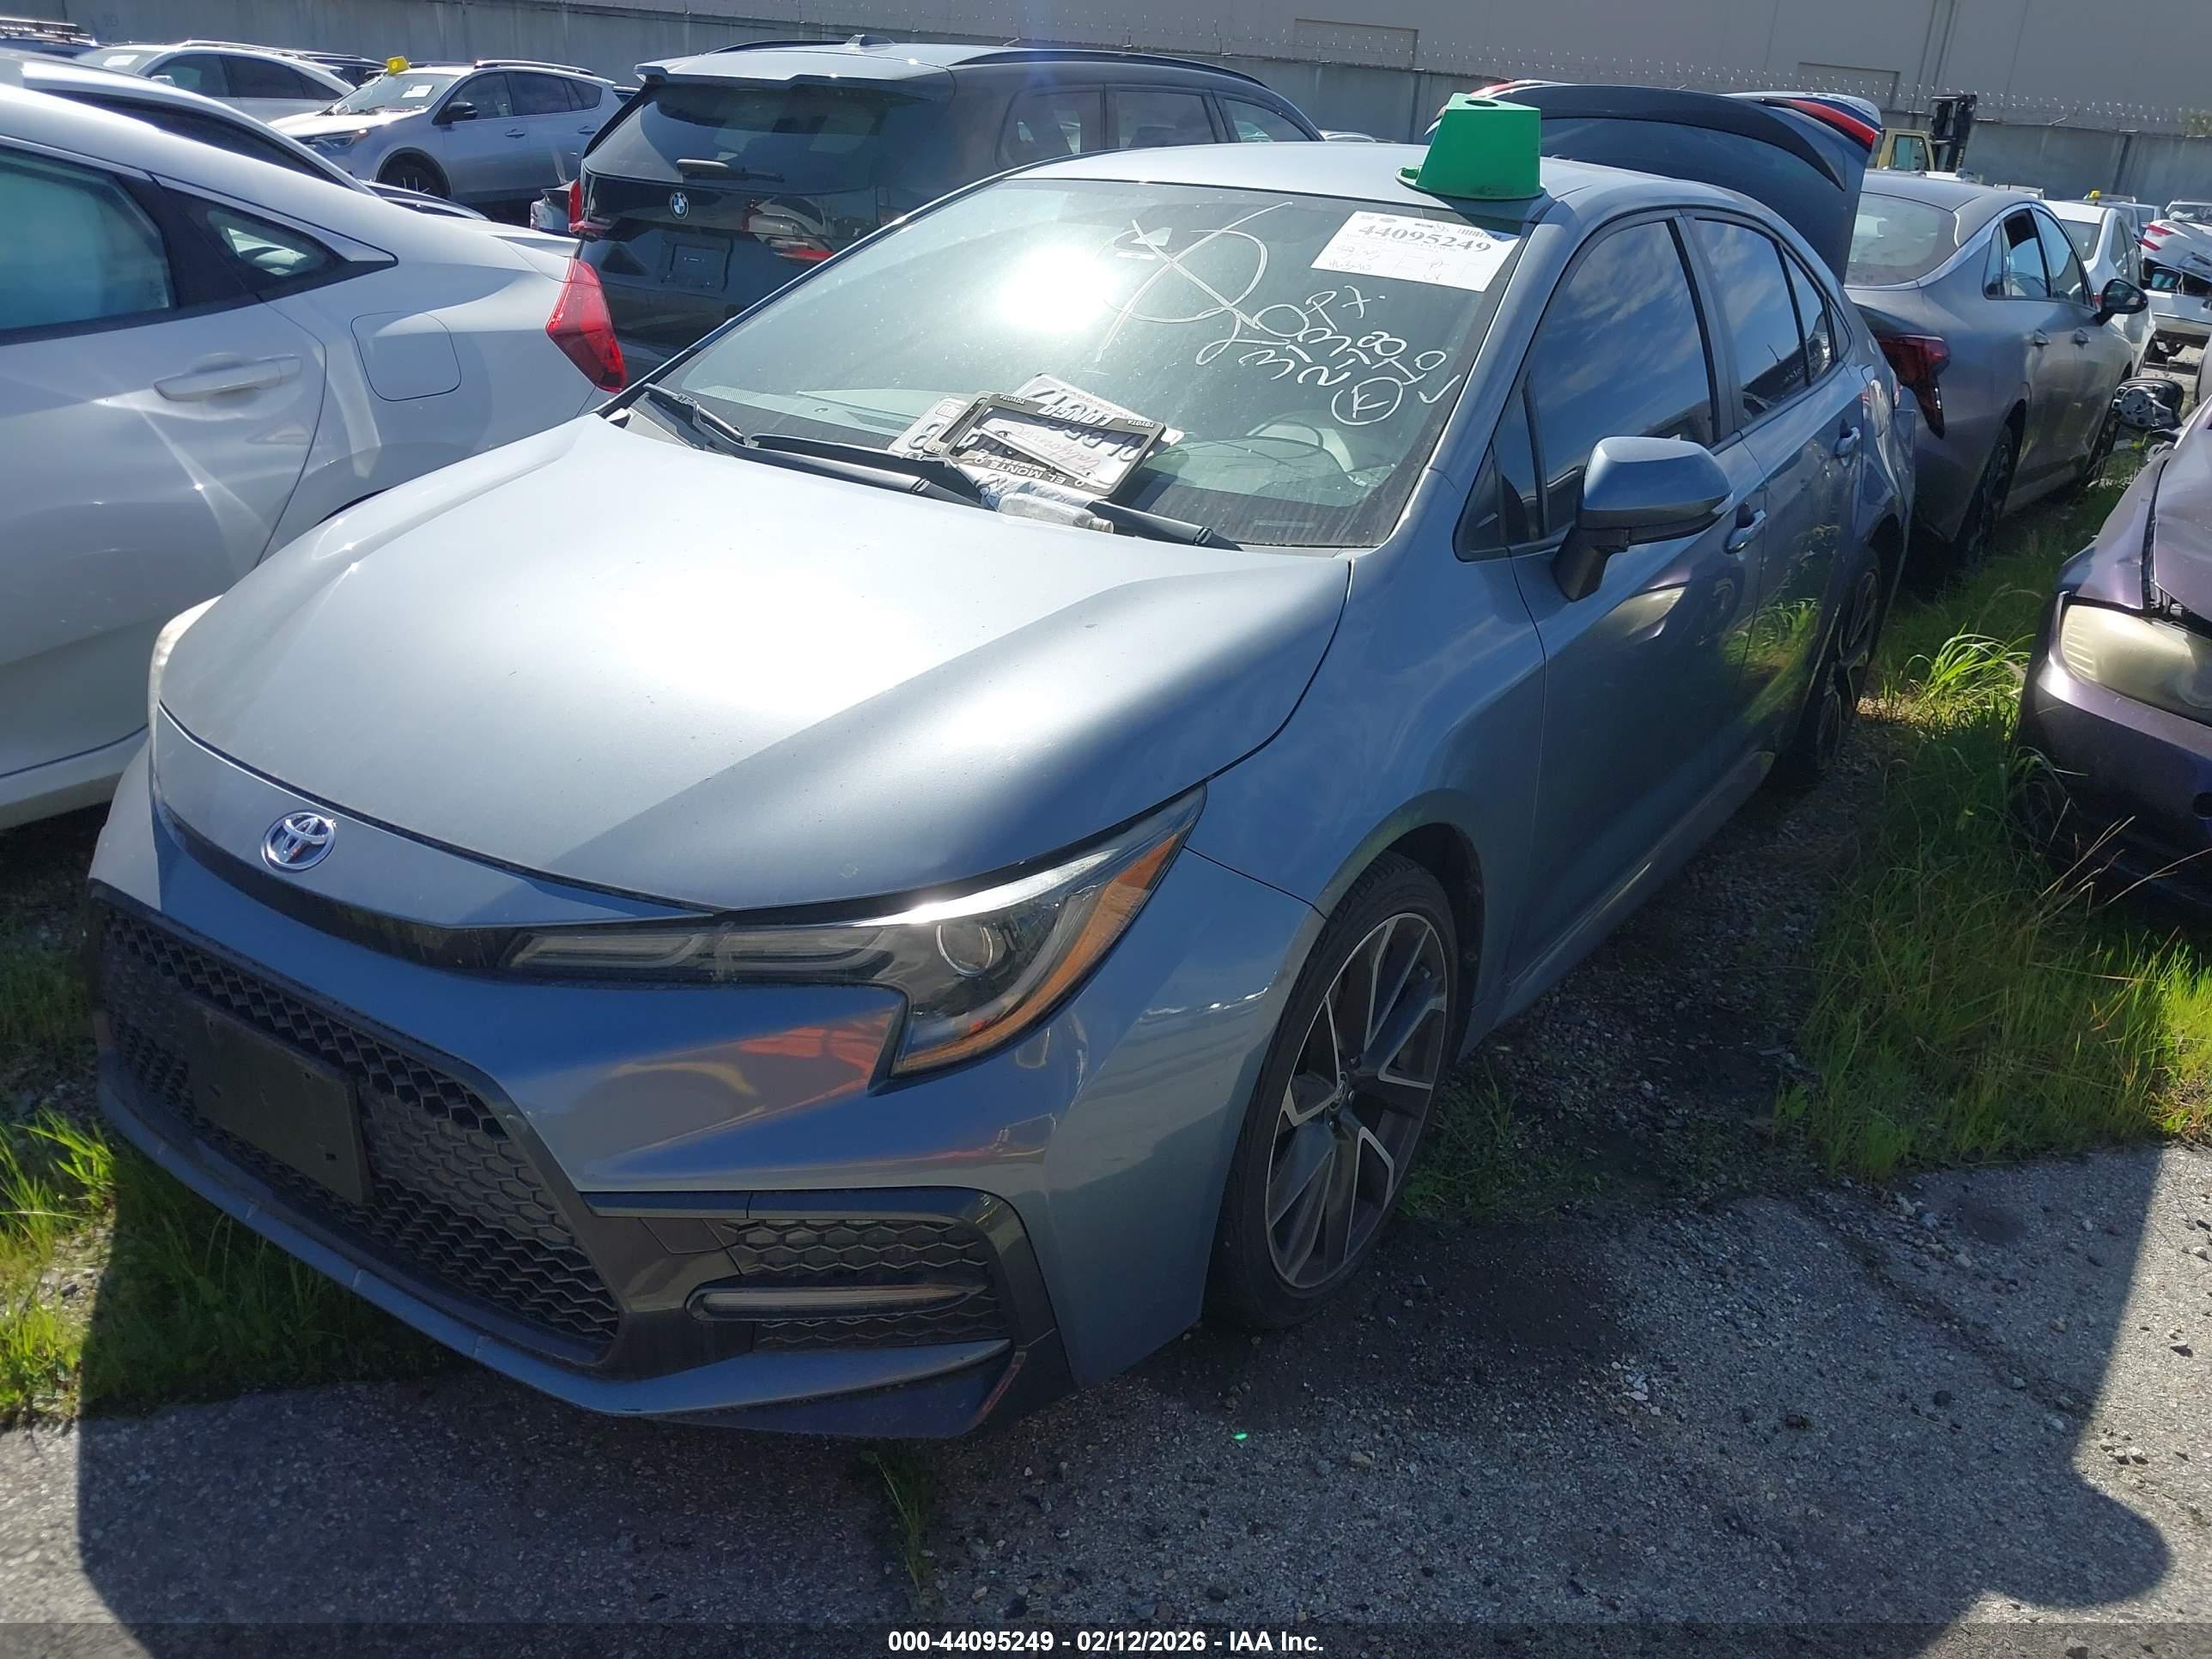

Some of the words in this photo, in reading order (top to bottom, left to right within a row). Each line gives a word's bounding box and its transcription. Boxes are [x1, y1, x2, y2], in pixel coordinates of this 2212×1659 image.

[1358, 223, 1492, 252] 44095249
[999, 393, 1026, 405] TOYOTA
[1036, 404, 1116, 427] LONGO
[1127, 418, 1156, 428] TOYOTA
[988, 461, 1046, 479] MONTE
[1048, 472, 1067, 484] EL
